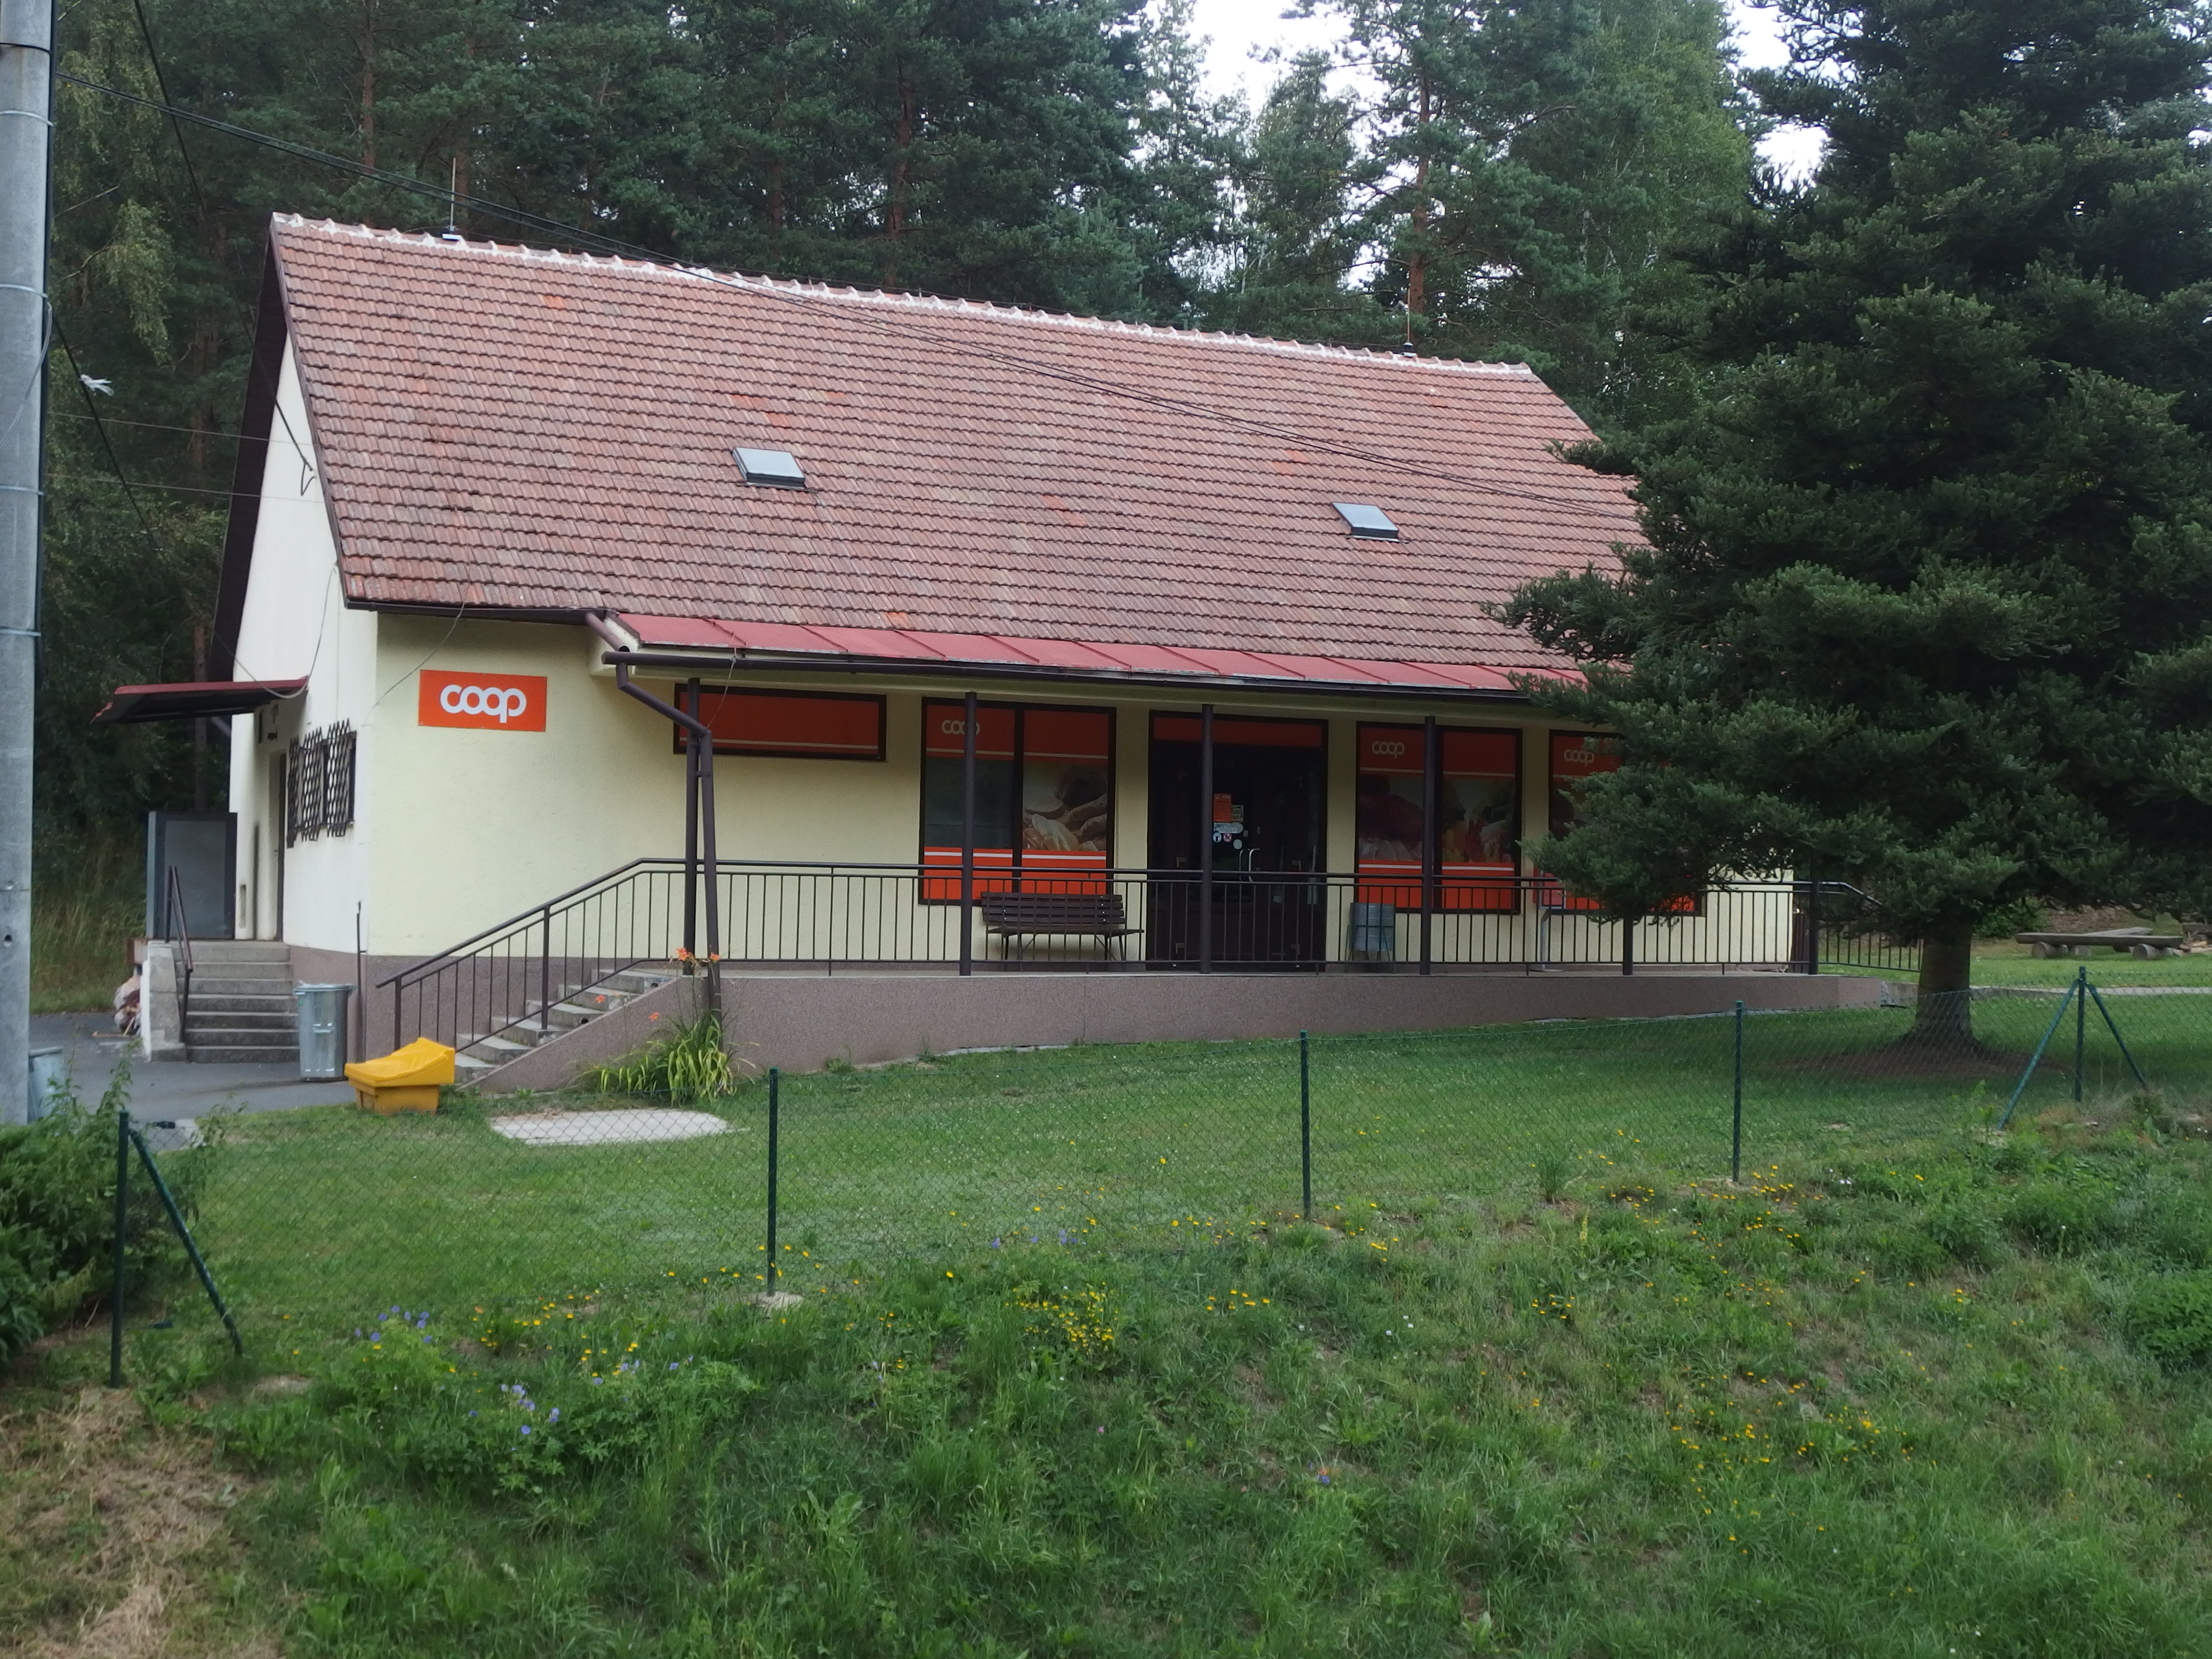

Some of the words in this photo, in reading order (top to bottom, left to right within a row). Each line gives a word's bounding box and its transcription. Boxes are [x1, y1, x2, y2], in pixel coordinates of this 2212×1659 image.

[440, 685, 526, 723] coop
[1371, 741, 1404, 758] coop
[1564, 749, 1595, 766] coop
